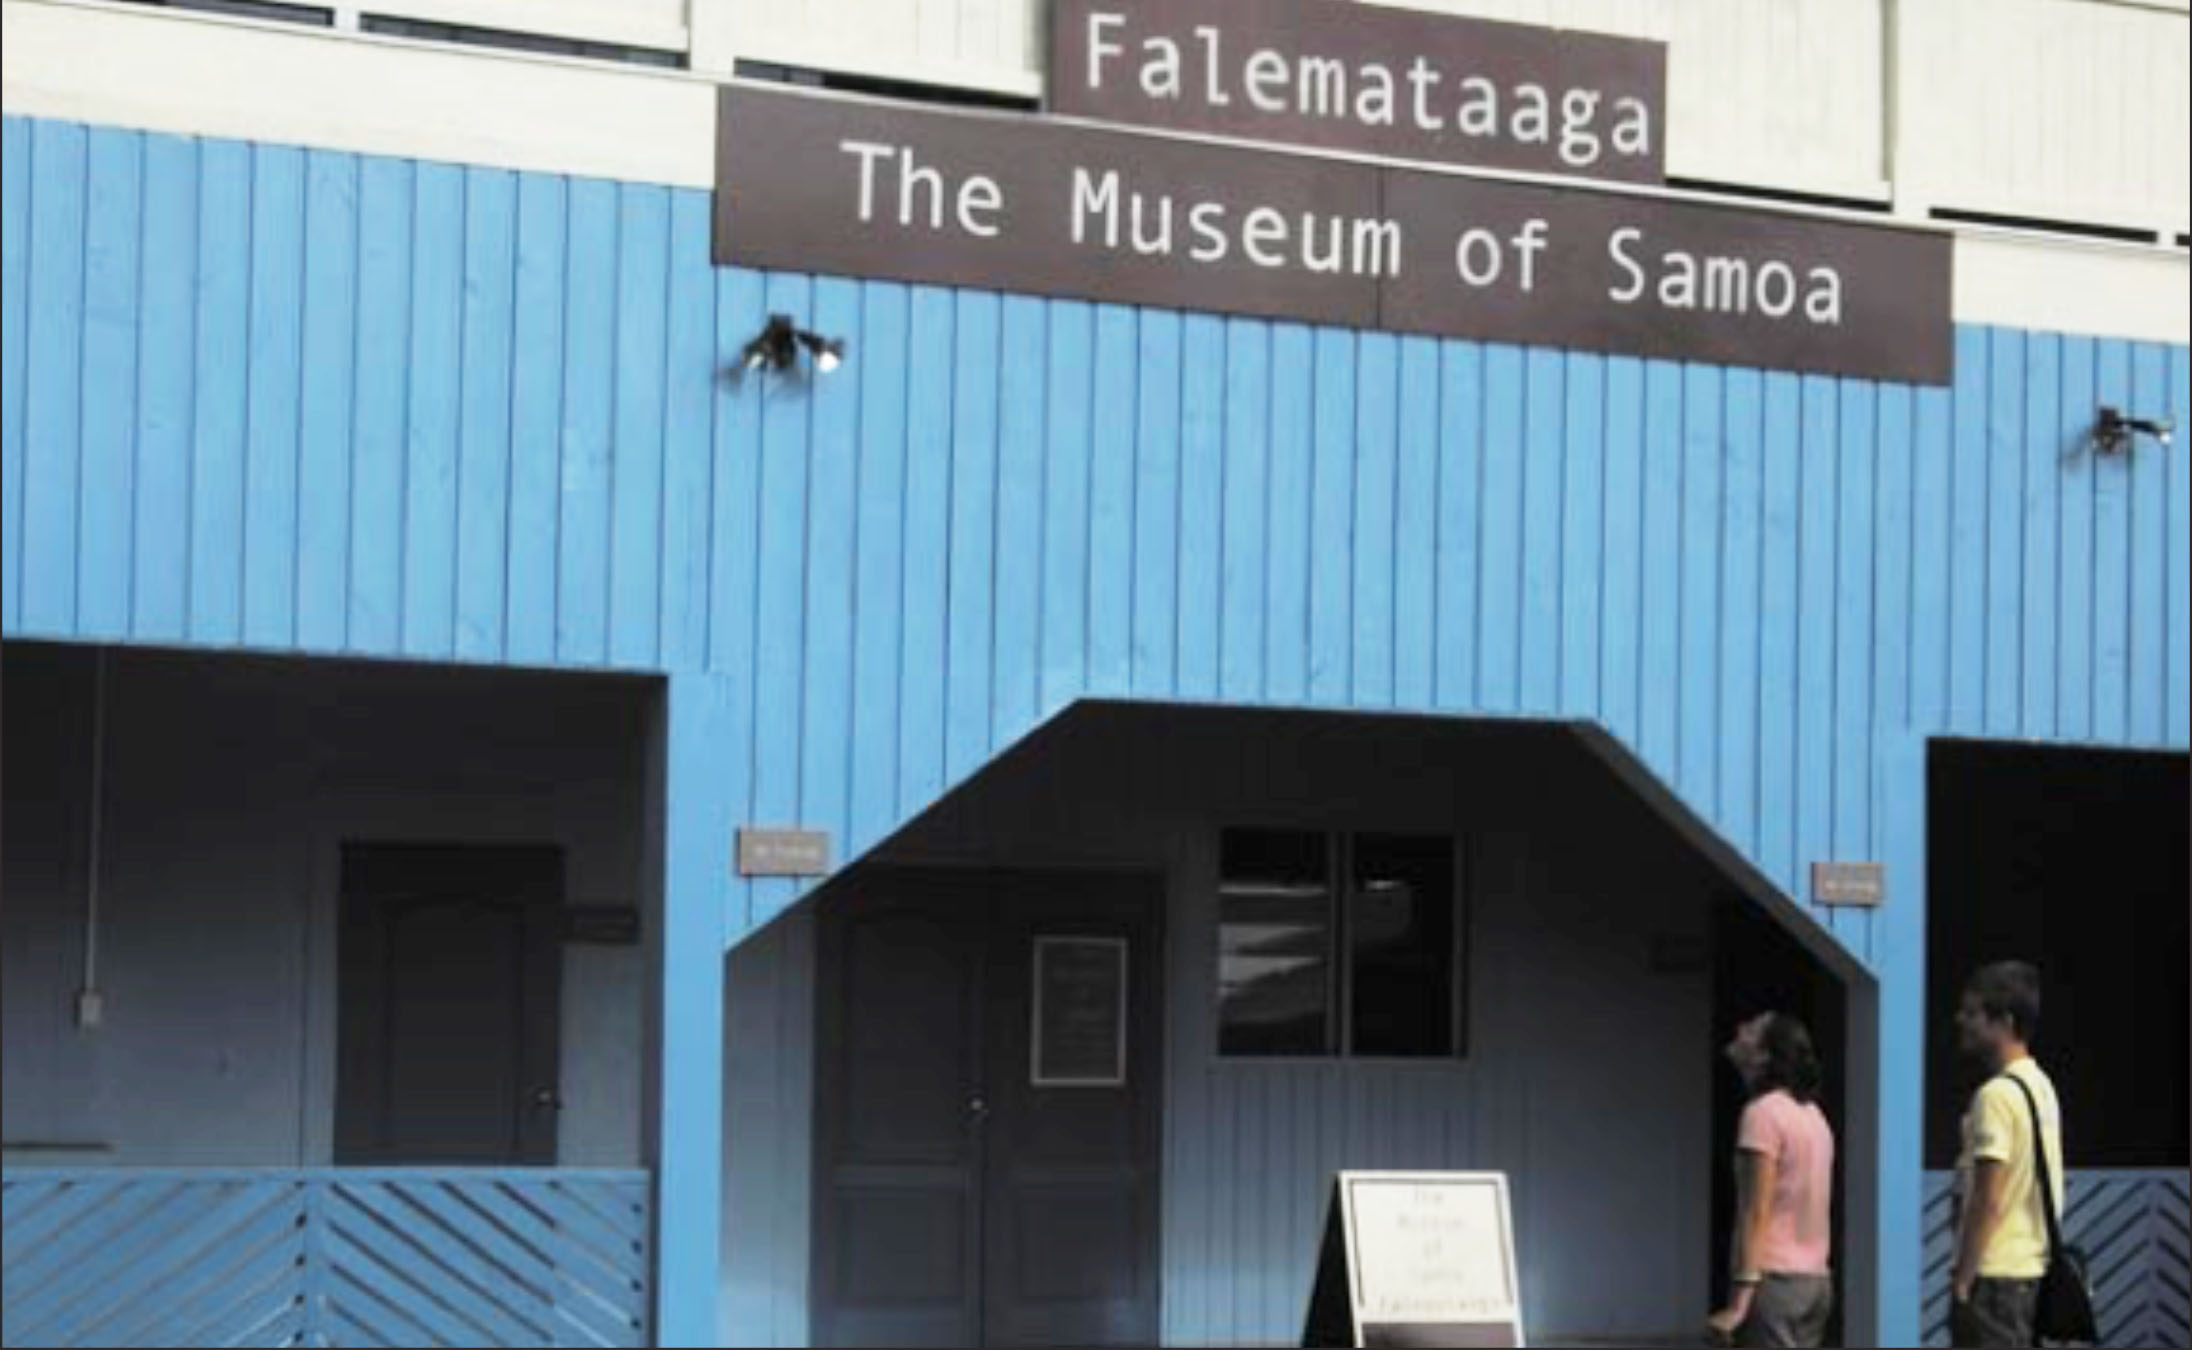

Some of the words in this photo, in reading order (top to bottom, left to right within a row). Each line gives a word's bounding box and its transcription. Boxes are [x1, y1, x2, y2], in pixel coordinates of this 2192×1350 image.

[1087, 12, 1650, 166] Falemataaga
[838, 139, 1004, 237] The
[1071, 167, 1402, 278] Museum
[1456, 218, 1549, 291] of
[1608, 227, 1842, 324] Samoa
